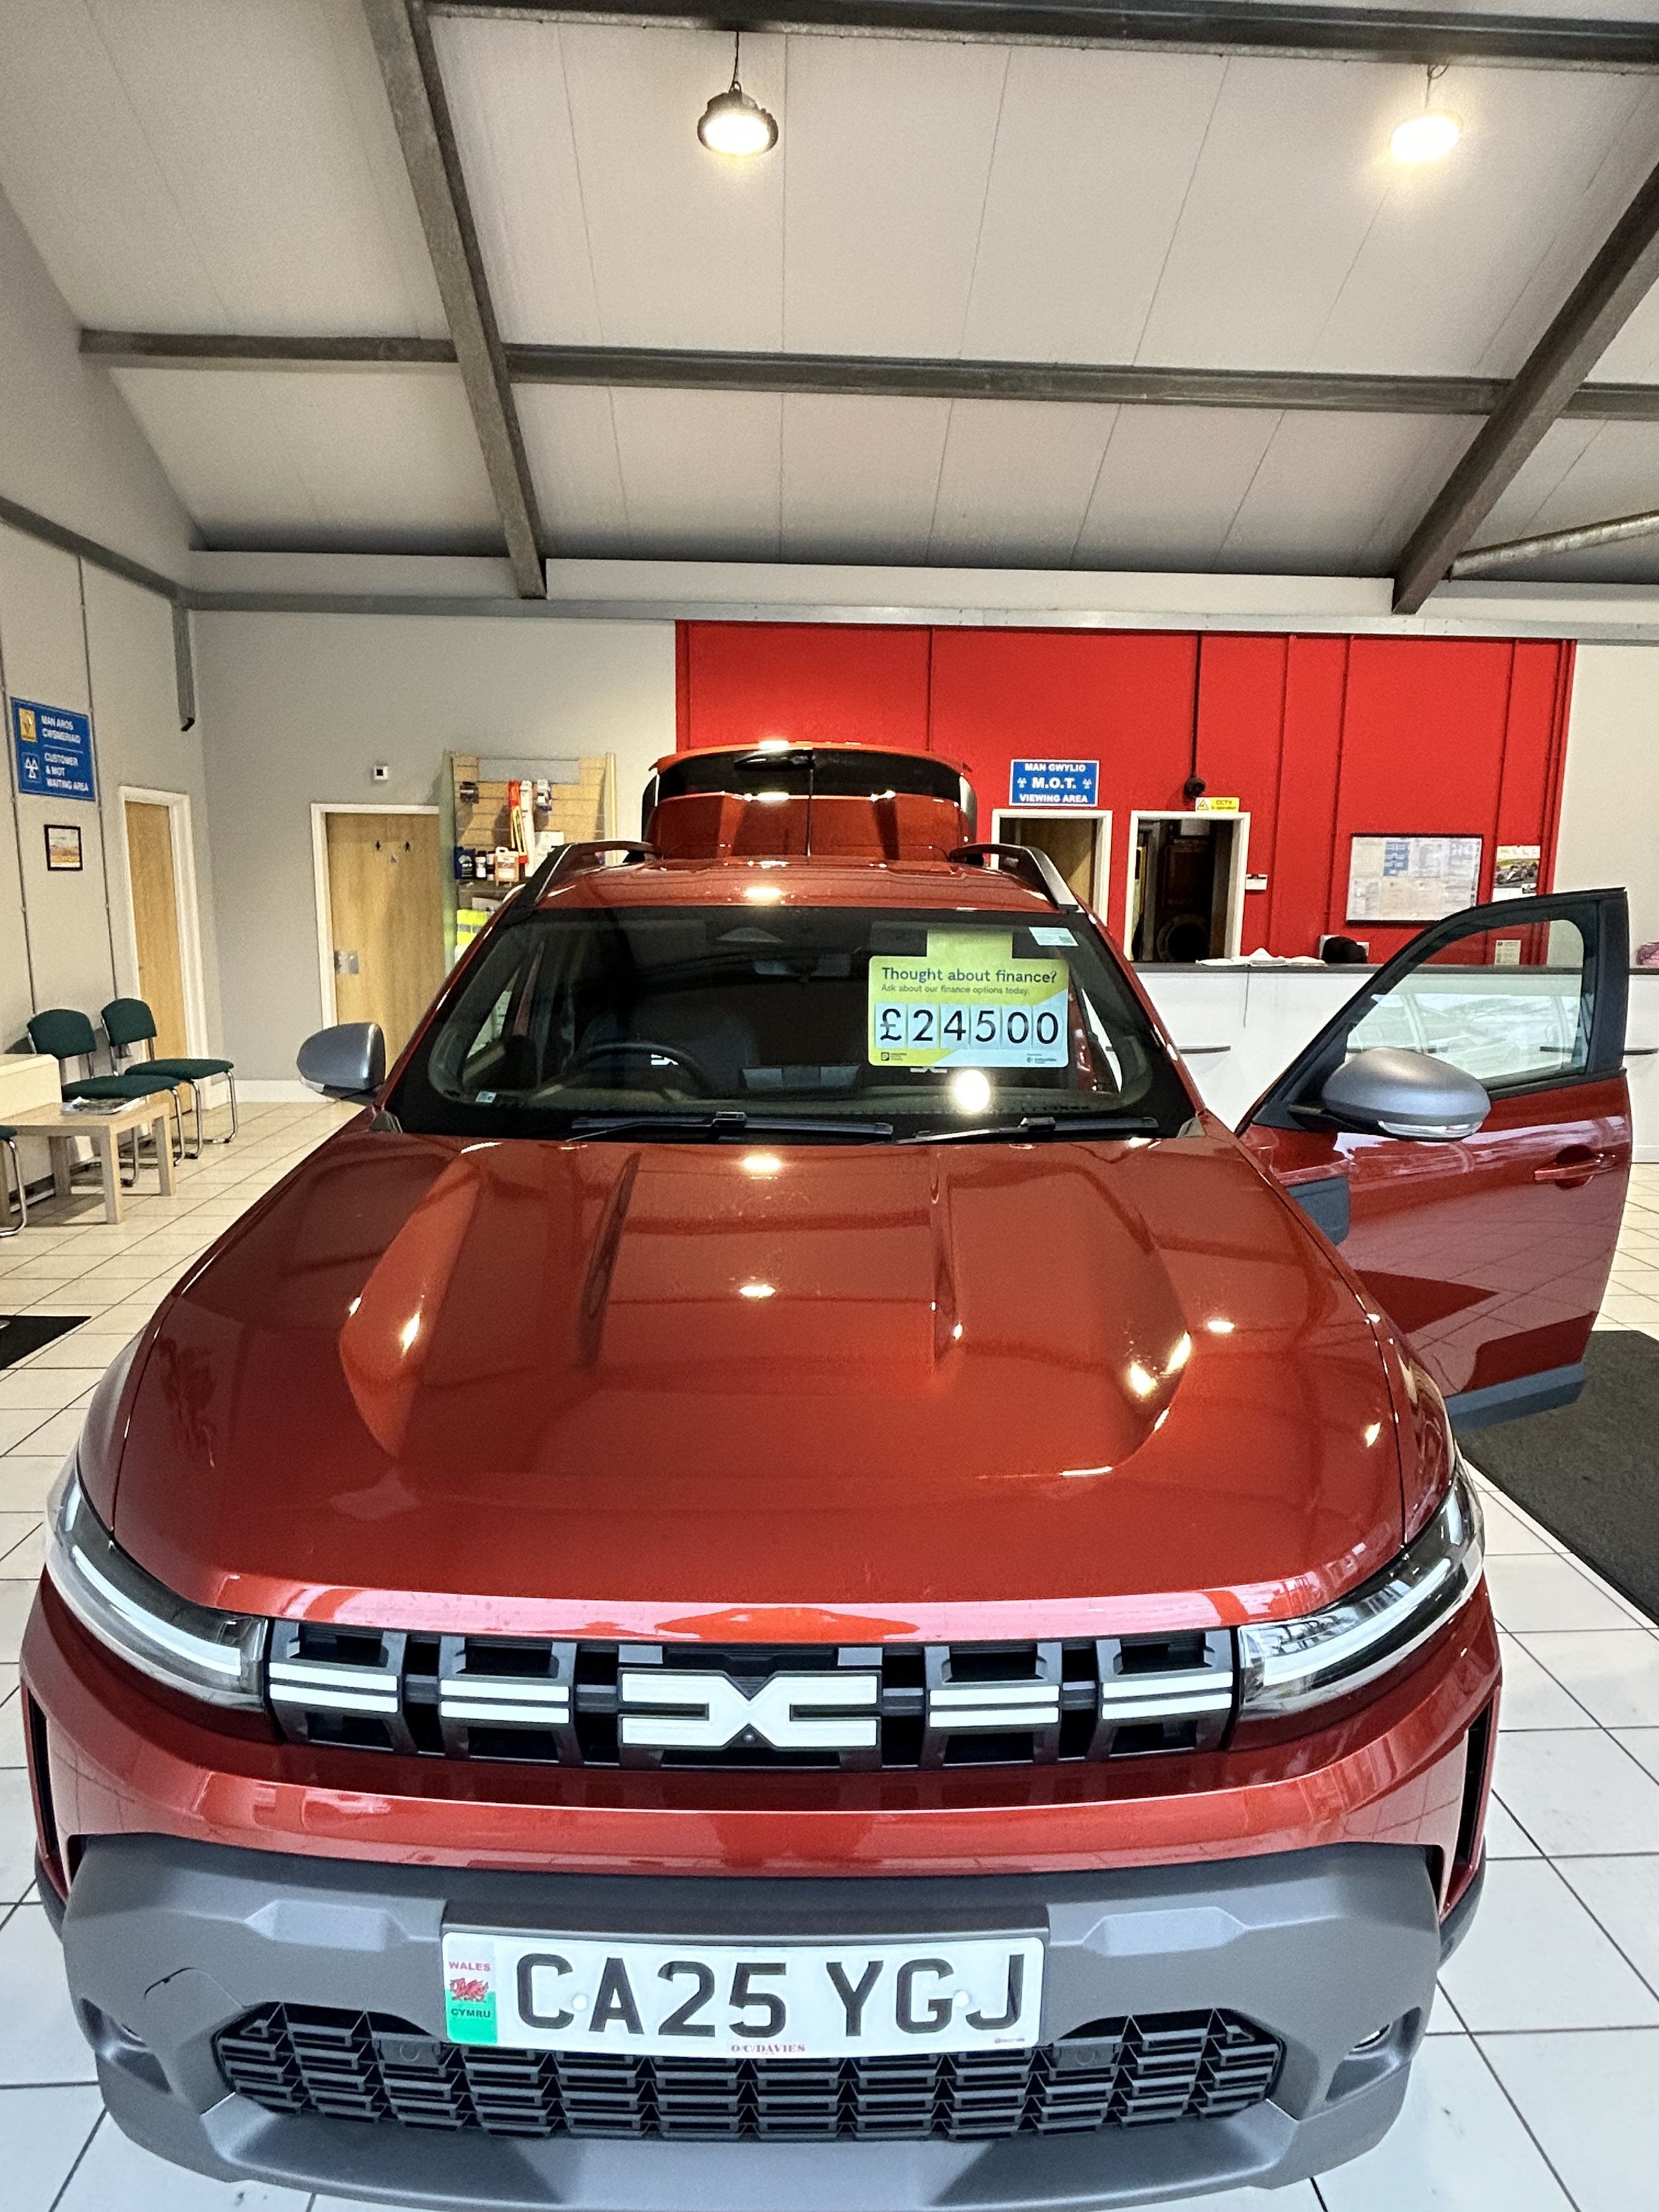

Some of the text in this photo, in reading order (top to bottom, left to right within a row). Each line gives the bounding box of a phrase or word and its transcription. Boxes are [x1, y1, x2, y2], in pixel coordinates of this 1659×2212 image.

[40, 715, 74, 731] MAN AROS
[44, 753, 78, 766] CUSTOMER
[45, 765, 52, 775] &
[1024, 763, 1086, 773] MAN GWYLIO
[46, 778, 89, 792] WAITING AREA
[1032, 776, 1076, 789] M.O.T.
[1019, 793, 1088, 803] VIEWING AREA
[881, 967, 1057, 984] Thought about finance?
[881, 984, 897, 992] Ask
[899, 984, 922, 993] about
[940, 985, 970, 994] finance
[972, 986, 1003, 995] options
[1005, 986, 1030, 996] today.
[879, 1007, 1059, 1045] £24500
[448, 1960, 491, 1972] WALES
[516, 1953, 1025, 2039] CA25 YGJ
[451, 2007, 491, 2019] CYMRU
